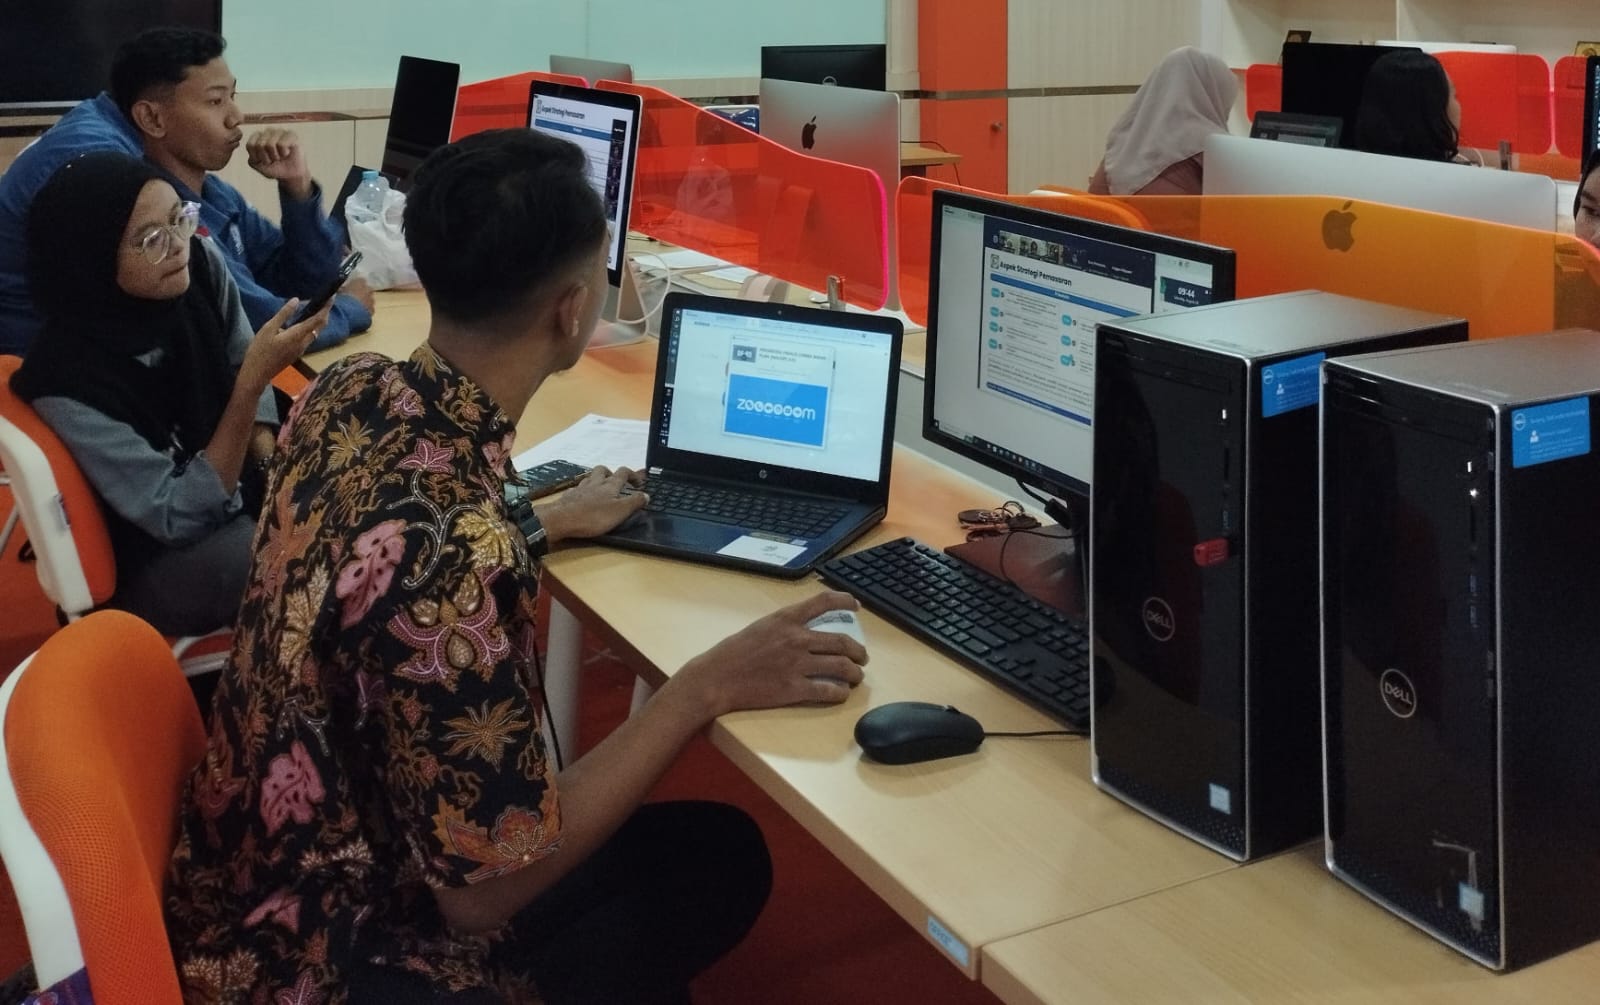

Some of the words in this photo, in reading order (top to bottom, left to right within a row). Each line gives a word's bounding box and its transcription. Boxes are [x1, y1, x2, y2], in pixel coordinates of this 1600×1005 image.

[1000, 261, 1016, 272] Aspek
[1017, 265, 1038, 279] Strategi
[1039, 271, 1072, 286] Pemasaran
[1147, 610, 1171, 629] DELL
[1385, 681, 1412, 705] DELL
